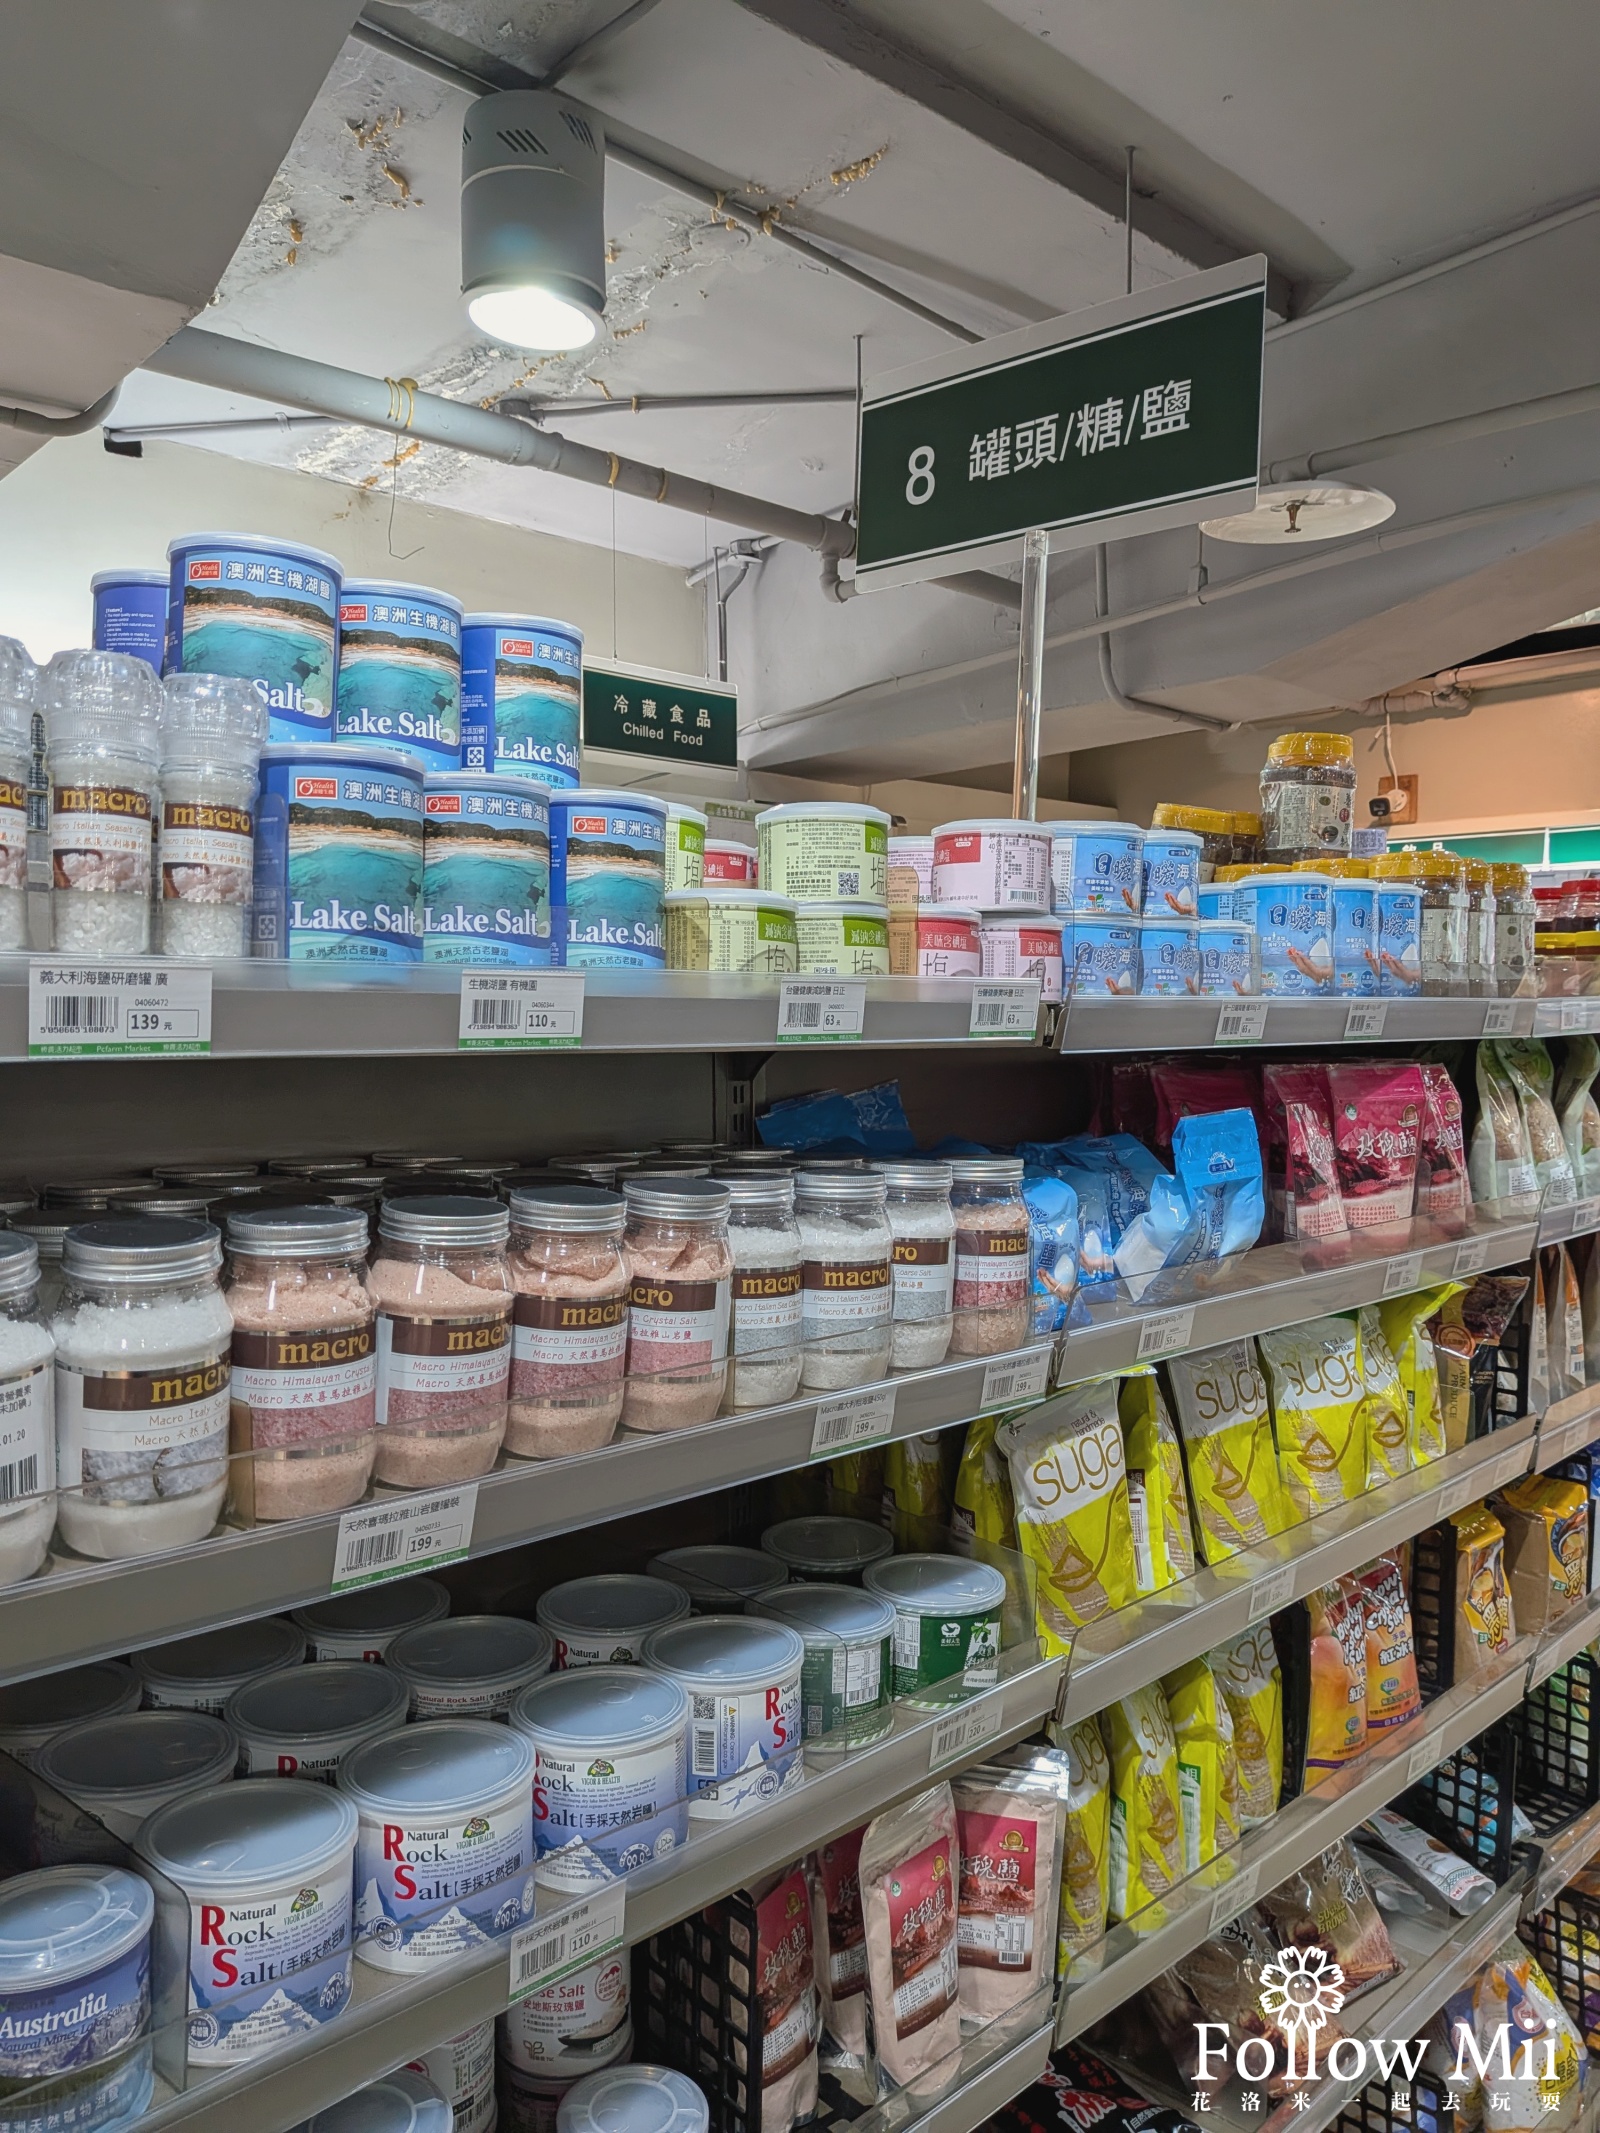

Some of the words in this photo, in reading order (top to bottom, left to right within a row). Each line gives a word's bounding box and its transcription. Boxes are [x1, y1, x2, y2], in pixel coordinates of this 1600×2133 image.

[905, 446, 935, 505] 8
[969, 379, 1191, 481] 罐頭/糖/鹽
[226, 561, 331, 600] 澳洲生機湖鹽
[613, 694, 711, 729] 冷藏食品
[336, 708, 392, 734] Lake
[398, 712, 442, 742] Salt
[622, 722, 664, 740] Chilled
[673, 730, 703, 746] Food
[497, 736, 551, 762] Lake
[62, 788, 147, 815] macro
[173, 806, 250, 830] macro
[292, 900, 368, 930] Lake
[374, 904, 415, 936] Salt
[424, 905, 491, 933] Lake
[495, 908, 538, 937] Salt
[568, 919, 628, 944] Lake
[40, 970, 152, 986] 義大利海鹽研磨罐
[135, 999, 168, 1007] 04060472
[131, 1014, 159, 1030] 139
[164, 1022, 172, 1030] 元
[528, 1015, 548, 1027] 110
[825, 1014, 834, 1025] 63
[1007, 1014, 1015, 1024] 63
[125, 1044, 151, 1052] Market
[1356, 1129, 1417, 1159] 玫瑰鹽
[741, 1274, 800, 1295] macro
[823, 1268, 887, 1287] macro
[629, 1287, 674, 1306] cro
[643, 1314, 676, 1325] Crystal
[679, 1317, 698, 1325] Salt
[530, 1333, 559, 1344] Macro
[278, 1333, 369, 1364] macro
[532, 1349, 563, 1360] Macro
[413, 1361, 445, 1371] Macro
[450, 1357, 496, 1371] Himalayan
[244, 1374, 277, 1386] Macro
[282, 1372, 341, 1386] Himalayan
[416, 1378, 450, 1388] Macro
[1016, 1381, 1027, 1392] 199
[248, 1393, 283, 1404] Macro
[149, 1414, 184, 1427] Macro
[189, 1405, 210, 1420] Italy
[855, 1422, 869, 1434] 199
[134, 1434, 170, 1448] Macro
[1033, 1423, 1123, 1506] suga
[414, 1521, 441, 1534] 04060733
[410, 1535, 432, 1553] 199
[434, 1539, 442, 1547] 元
[570, 1647, 600, 1659] Natural
[470, 1695, 485, 1703] Salt
[969, 1725, 980, 1738] 220
[302, 1756, 339, 1769] Natural
[542, 1758, 575, 1773] Natural
[581, 1777, 597, 1785] VIGOR
[602, 1775, 620, 1785] HEALTH
[383, 1824, 449, 1863] Rock
[407, 1829, 449, 1842] Natural
[456, 1839, 472, 1849] VIGOR
[477, 1830, 496, 1844] HEALTH
[394, 1865, 455, 1900] Salt
[229, 1904, 277, 1922] Natural
[283, 1914, 300, 1926] VIGOR
[305, 1901, 324, 1919] HEALTH
[201, 1904, 275, 1946] Rock
[517, 1914, 570, 1949] 手採天然岩鹽
[572, 1933, 591, 1952] 110
[212, 1948, 281, 1988] Salt
[559, 1984, 585, 1998] Salt
[523, 2000, 584, 2013] 安地斯玫瑰鹽
[0, 1993, 108, 2039] Australia
